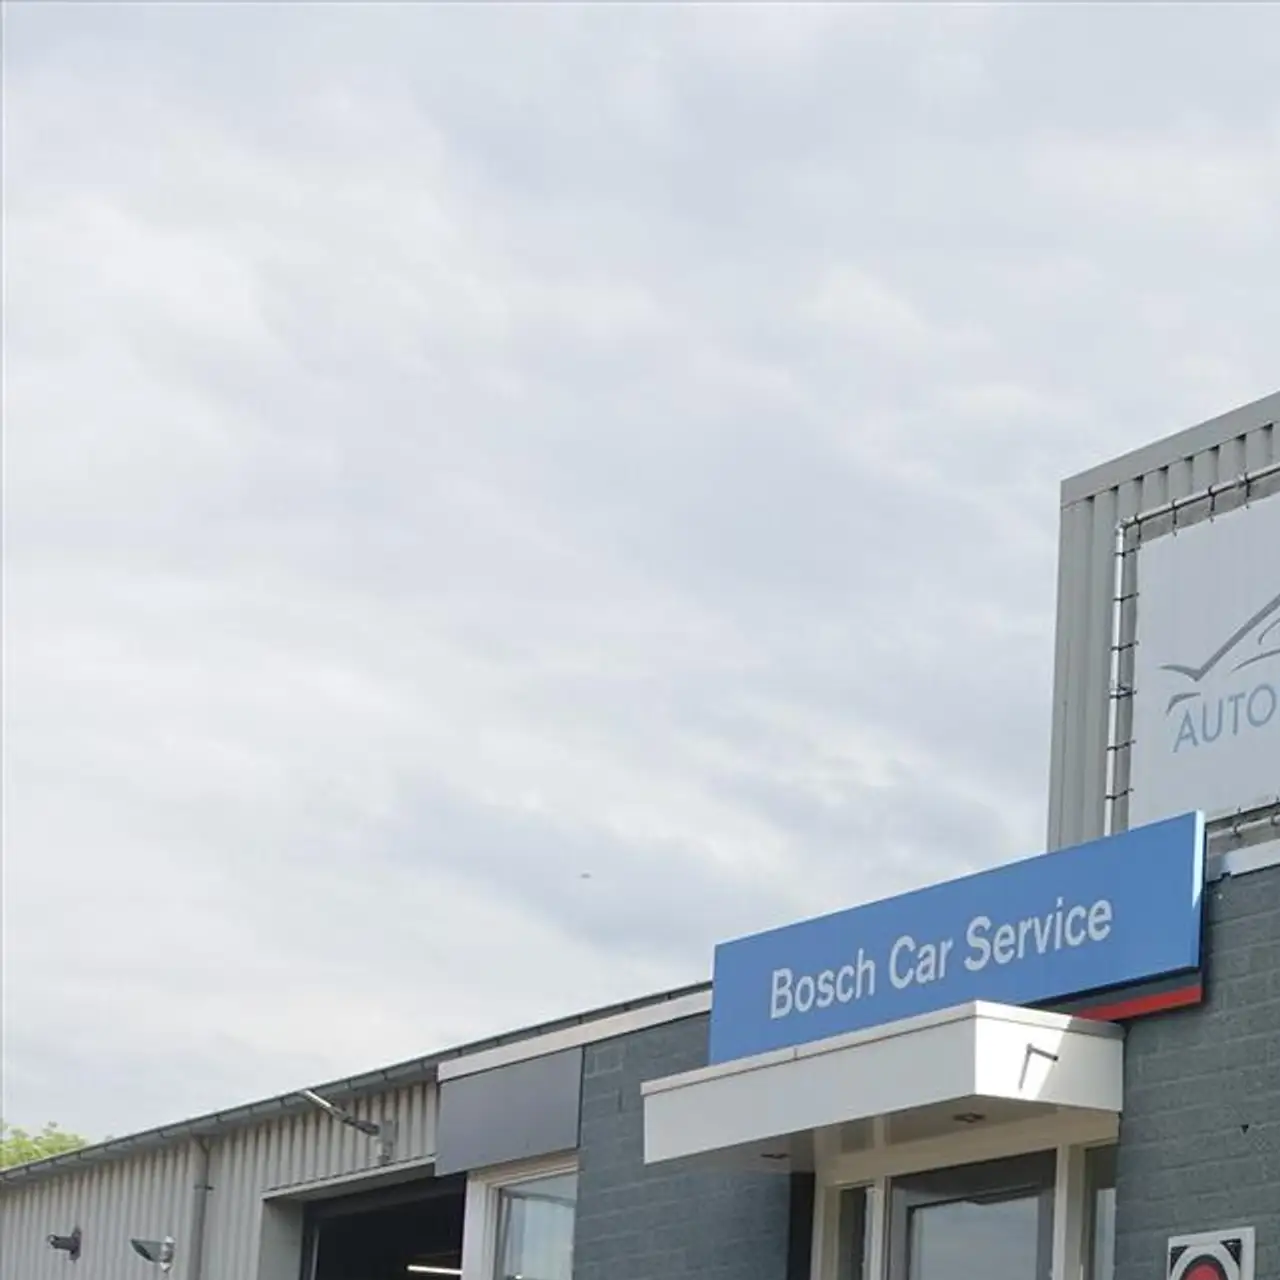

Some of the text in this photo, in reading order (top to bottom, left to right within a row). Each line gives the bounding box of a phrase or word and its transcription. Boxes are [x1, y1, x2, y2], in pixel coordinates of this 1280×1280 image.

[770, 896, 1113, 1020] Bosch Car Service
